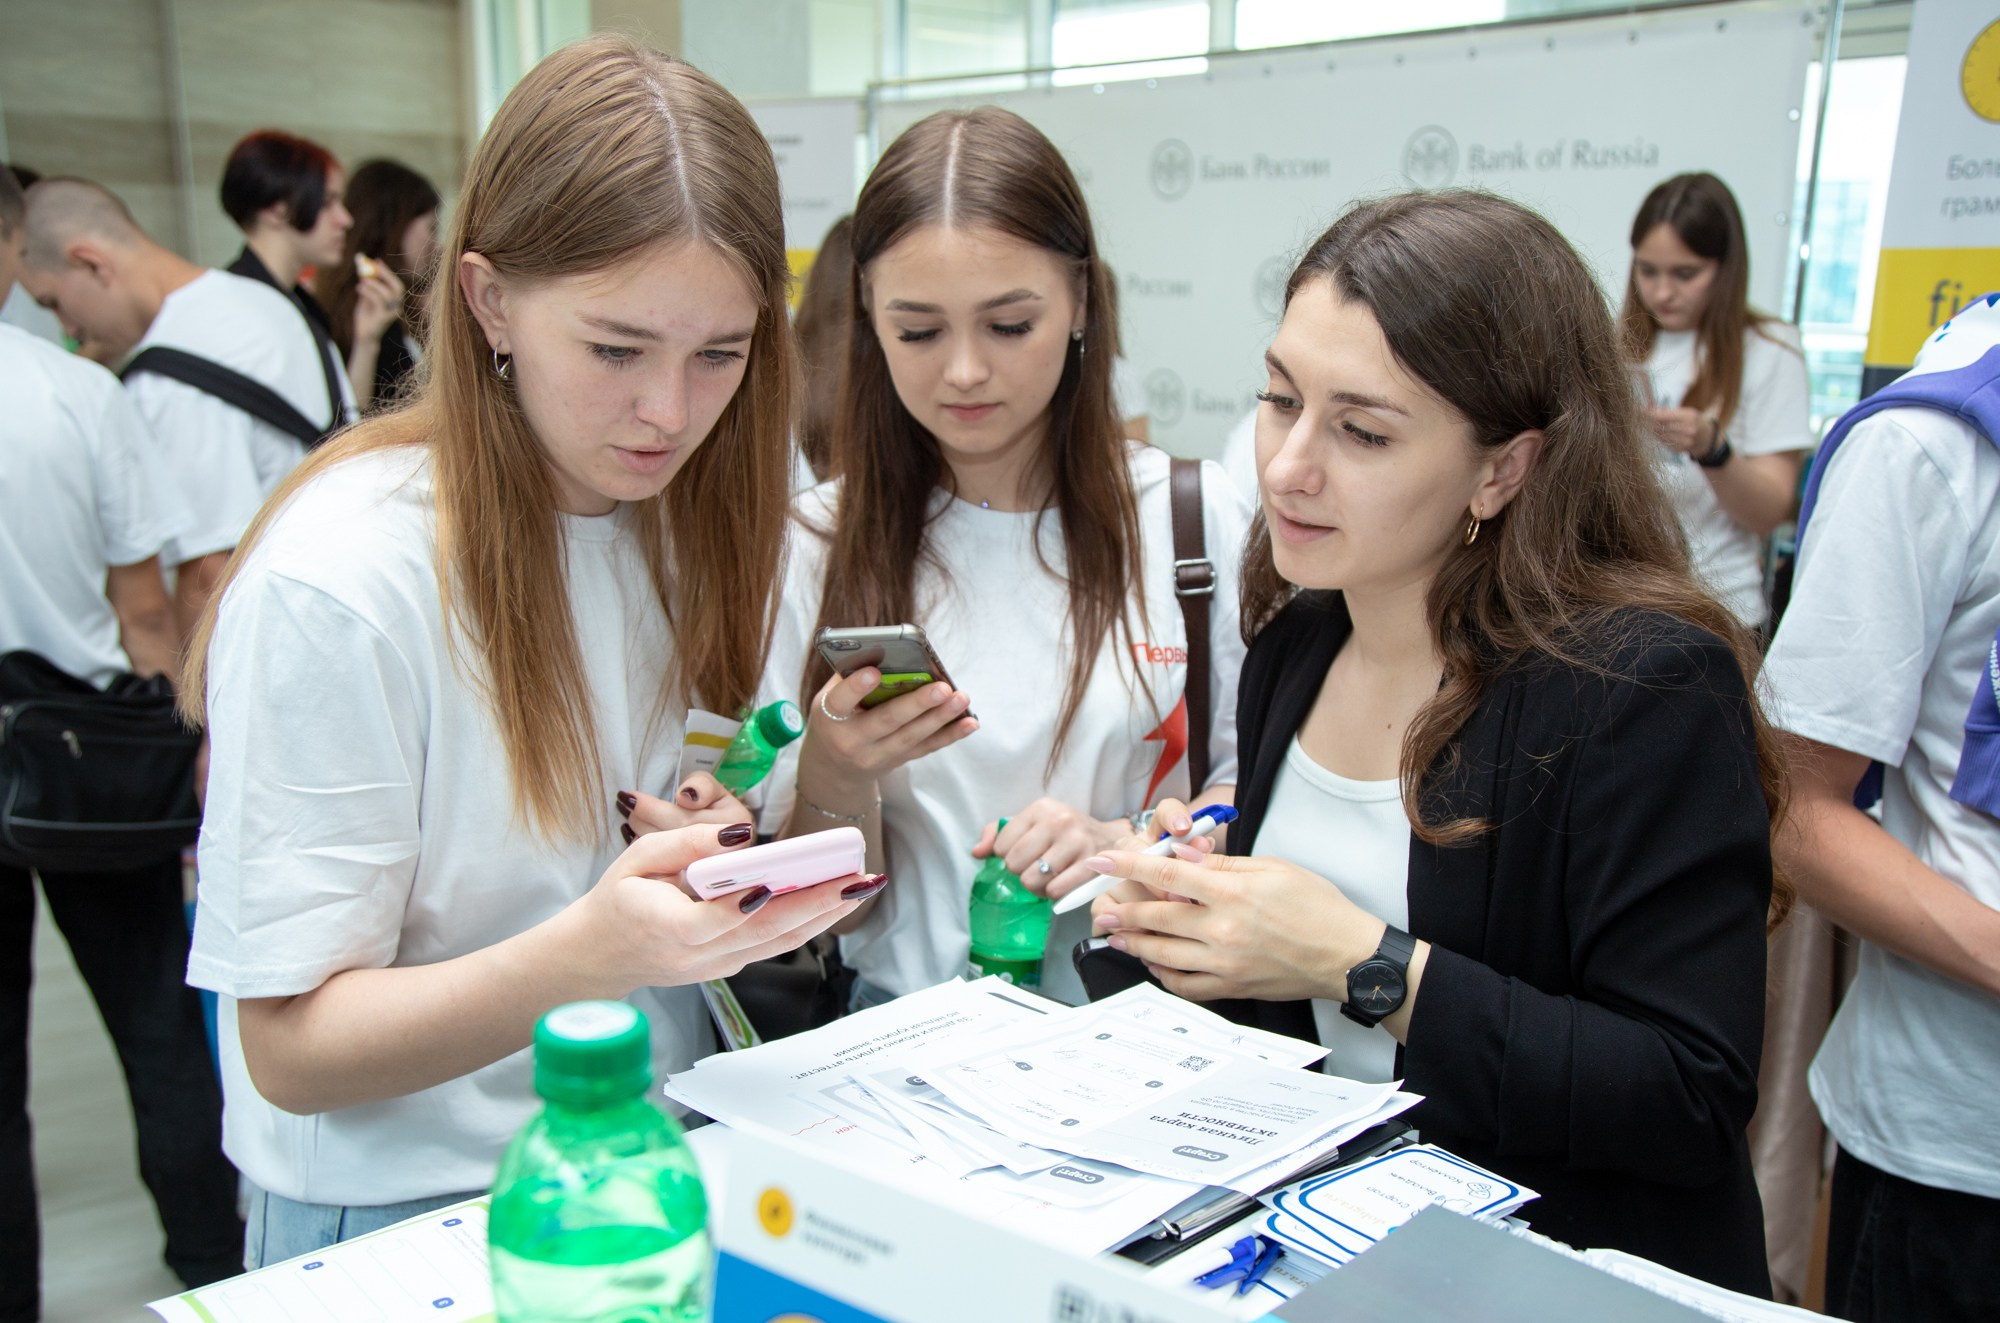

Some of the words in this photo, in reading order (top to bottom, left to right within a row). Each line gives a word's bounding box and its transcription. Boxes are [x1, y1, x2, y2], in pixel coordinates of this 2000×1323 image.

[1468, 139, 1529, 172] Bank
[1535, 138, 1565, 171] of
[1571, 136, 1659, 170] Russia
[872, 1028, 909, 1042] купить
[883, 1032, 920, 1048] можно
[833, 1040, 872, 1058] знания
[845, 1046, 883, 1062] купить
[790, 1060, 844, 1080] аттестат,
[1150, 1115, 1197, 1133] карта
[1177, 1112, 1278, 1137] активности
[1198, 1126, 1264, 1145] Личная
[1409, 1159, 1463, 1184] Коллектор
